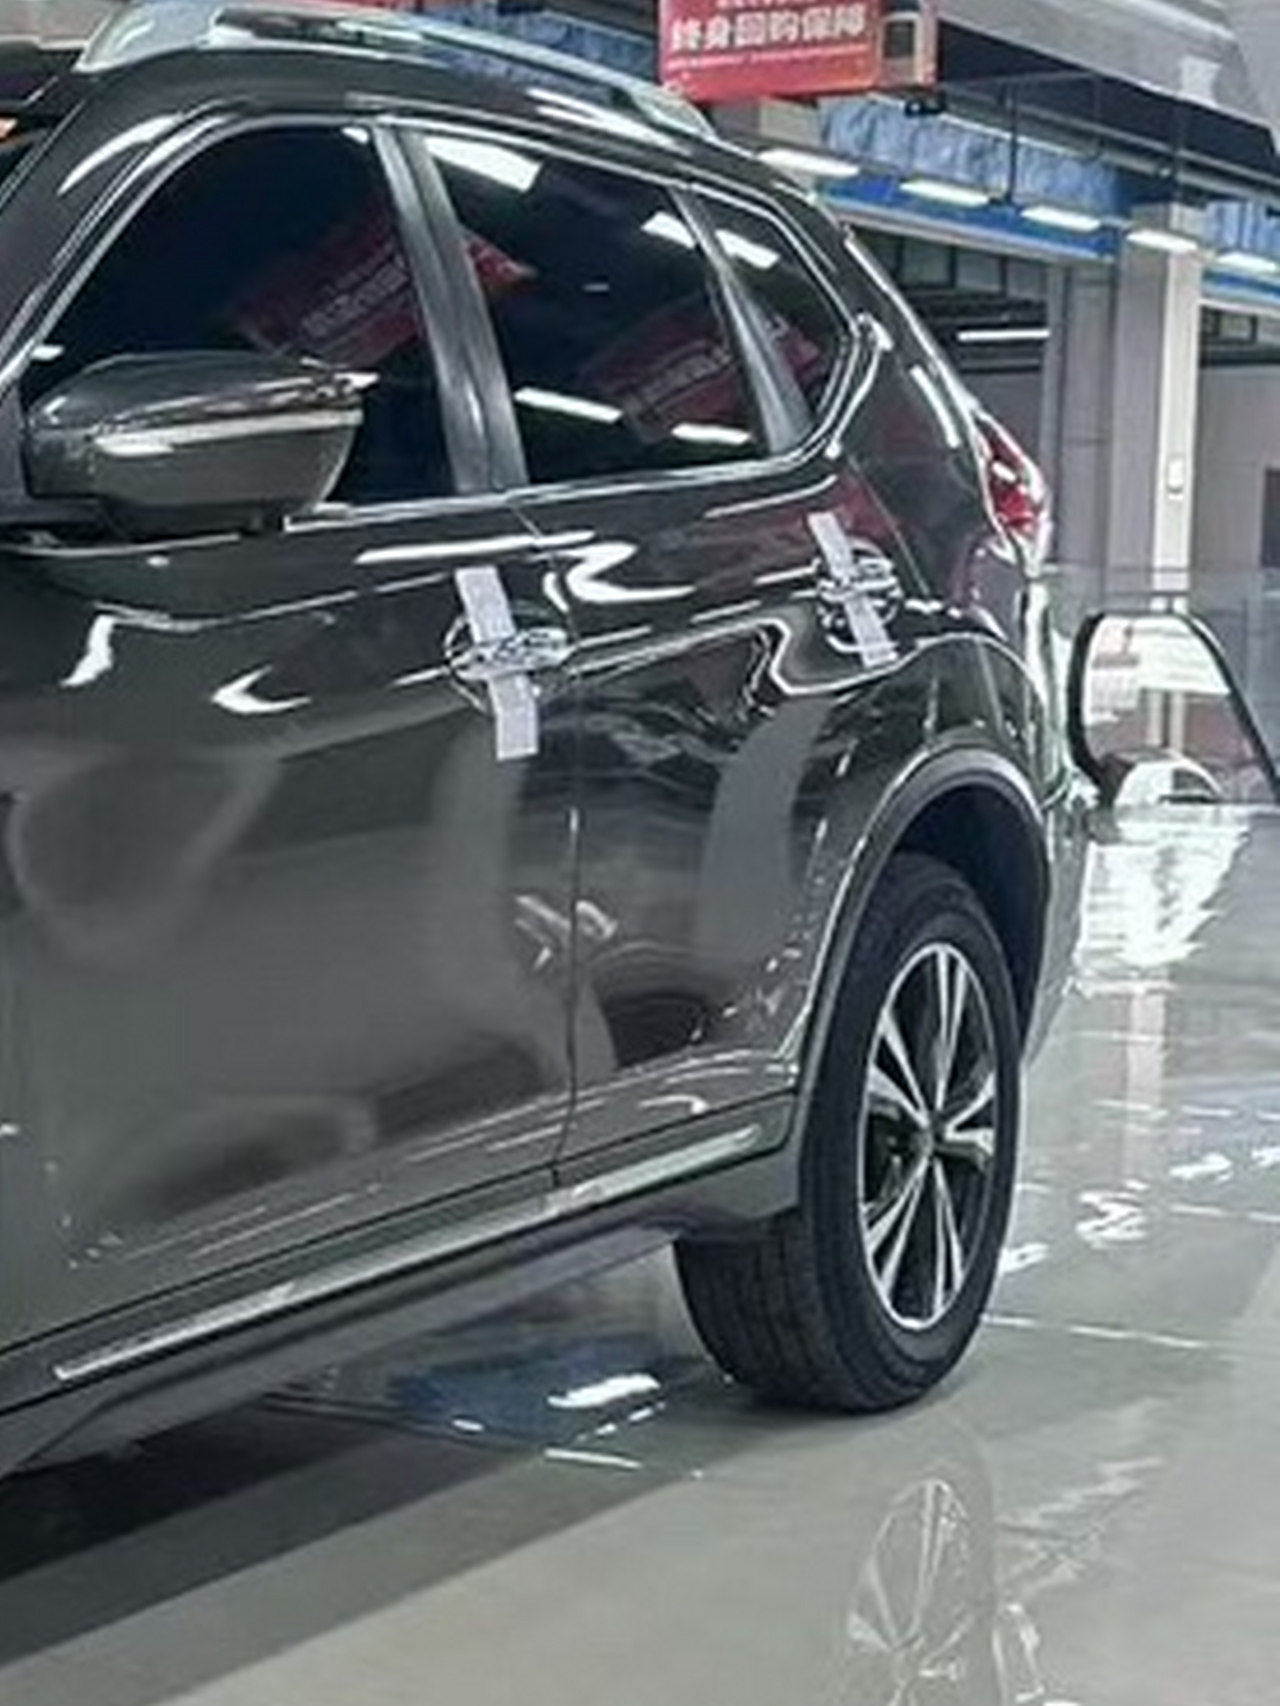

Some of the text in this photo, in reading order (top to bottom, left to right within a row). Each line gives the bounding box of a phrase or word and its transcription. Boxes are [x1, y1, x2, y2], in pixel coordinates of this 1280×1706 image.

[671, 3, 867, 51] 终身回购保障
